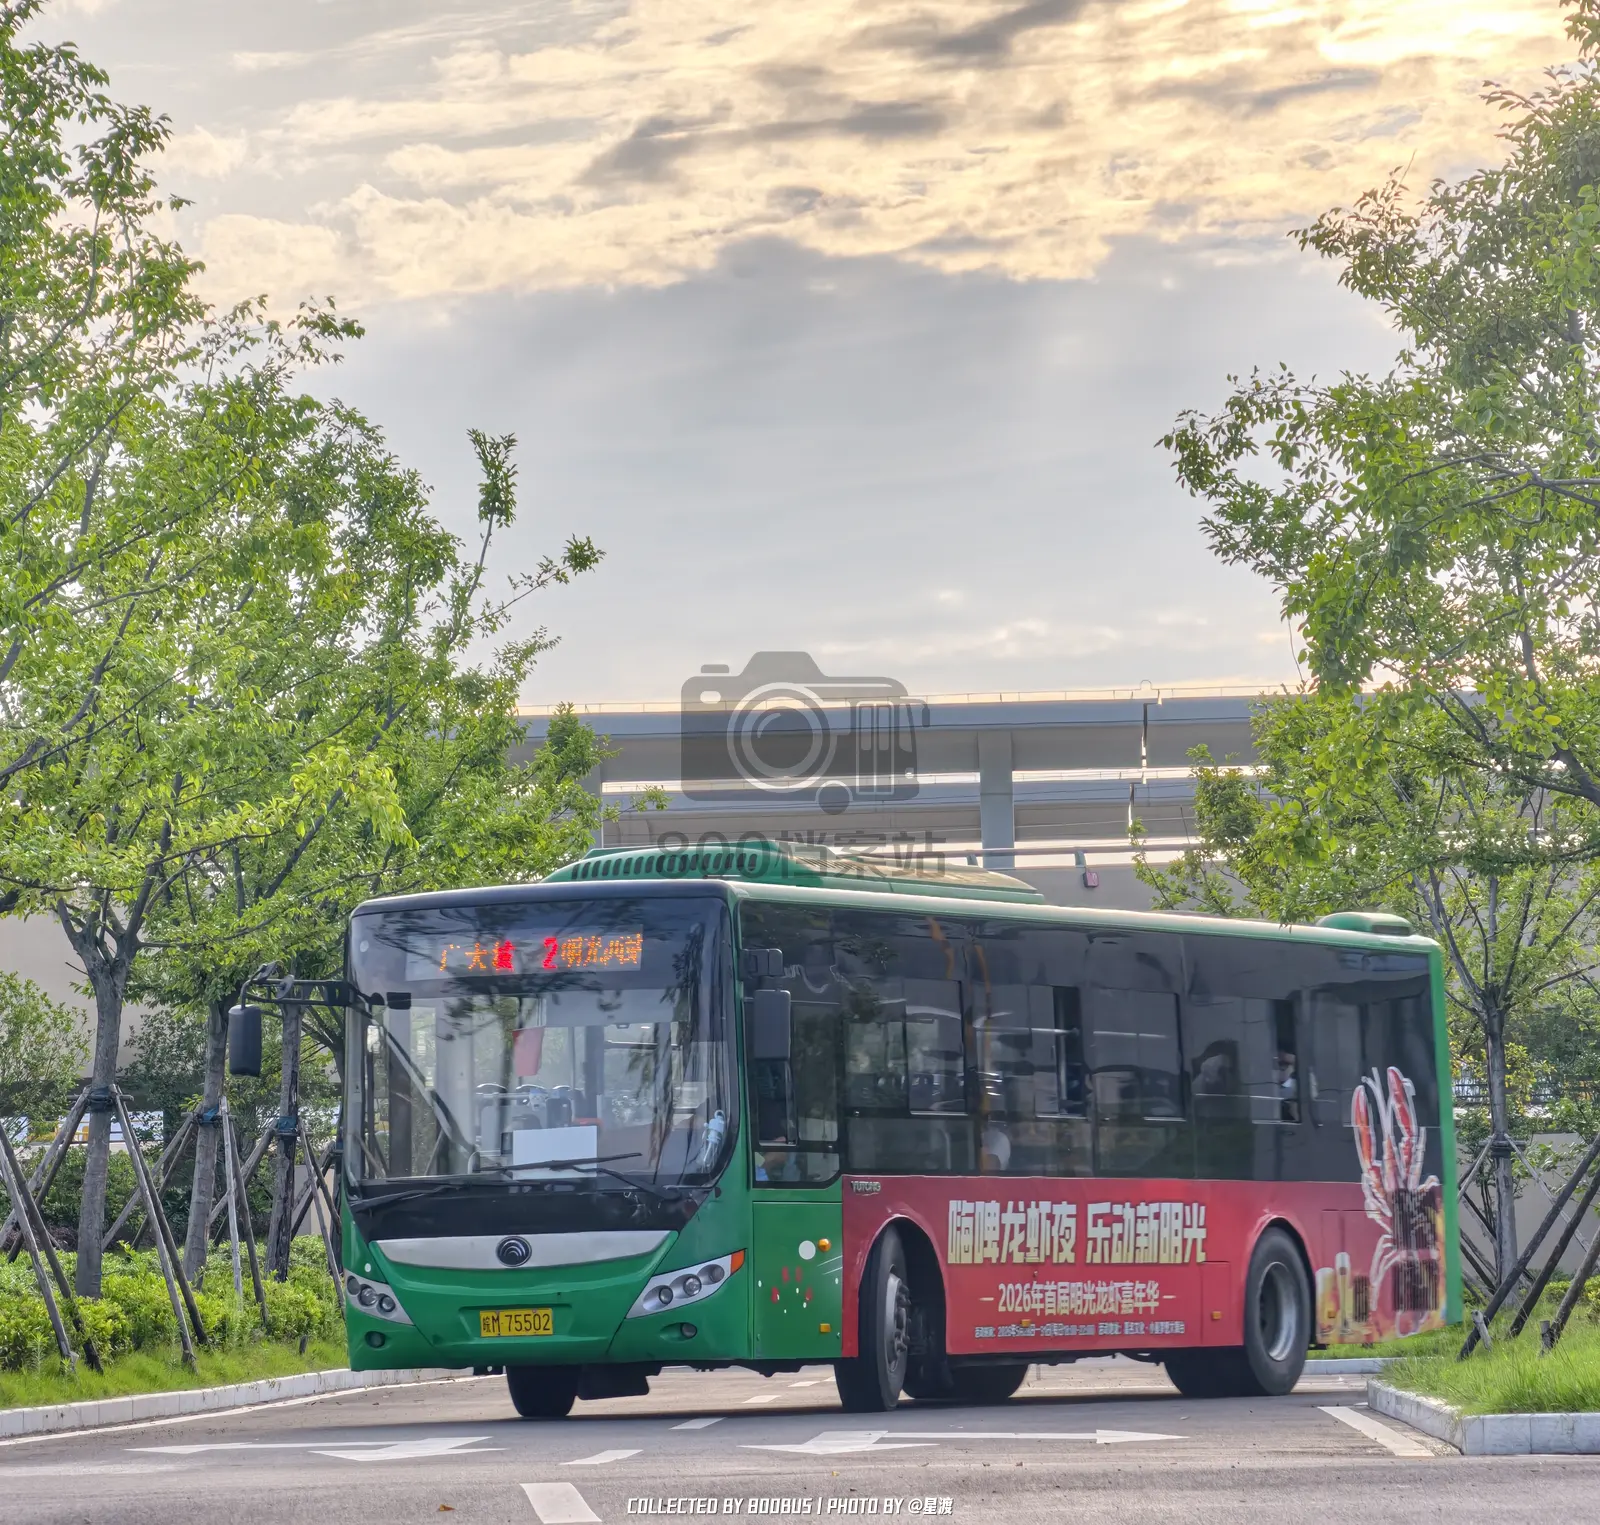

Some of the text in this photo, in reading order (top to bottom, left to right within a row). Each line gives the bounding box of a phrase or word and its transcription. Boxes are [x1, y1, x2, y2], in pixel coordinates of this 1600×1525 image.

[542, 936, 558, 970] 2
[850, 1180, 881, 1193] YUTONG
[947, 1200, 1207, 1264] 嗨啤龙虾夜 乐动新明光
[998, 1280, 1160, 1317] 2026年首届明光龙虾嘉年华
